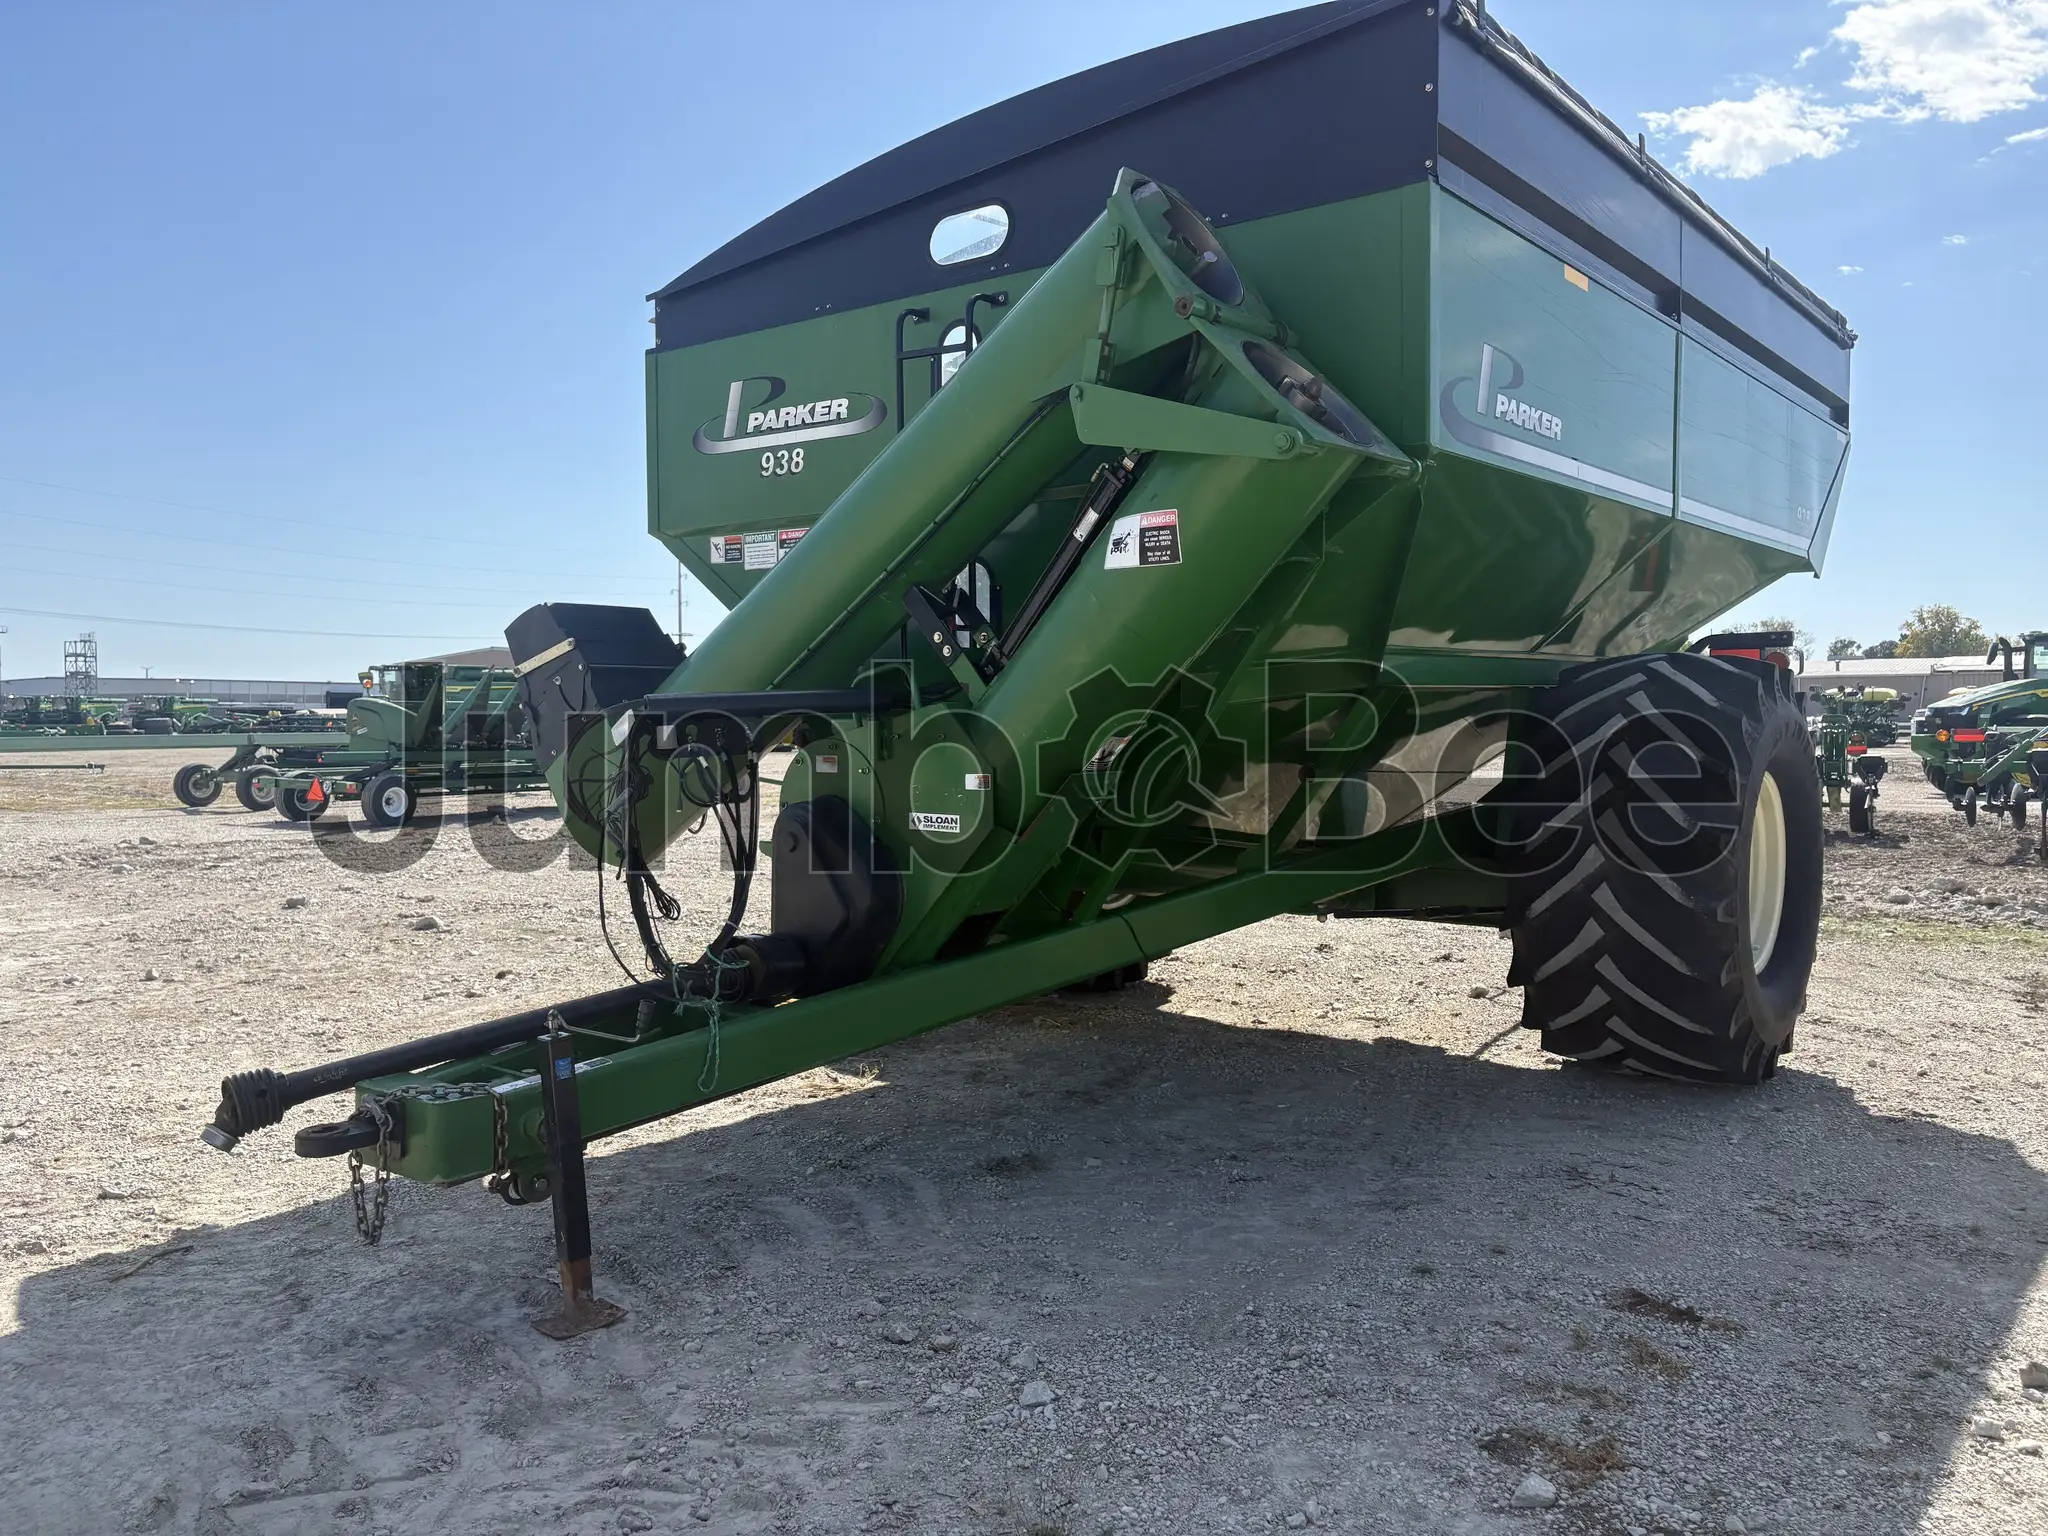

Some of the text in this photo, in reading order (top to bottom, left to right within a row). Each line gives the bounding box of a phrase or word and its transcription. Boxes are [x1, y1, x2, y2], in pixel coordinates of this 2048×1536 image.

[746, 398, 849, 434] PARKER
[1495, 392, 1562, 440] PARKER
[760, 448, 804, 478] 938
[1148, 515, 1175, 523] DANGER
[745, 532, 775, 543] IMPORTANT
[923, 815, 958, 826] SLOAN
[923, 823, 958, 831] IMPLEMENT
